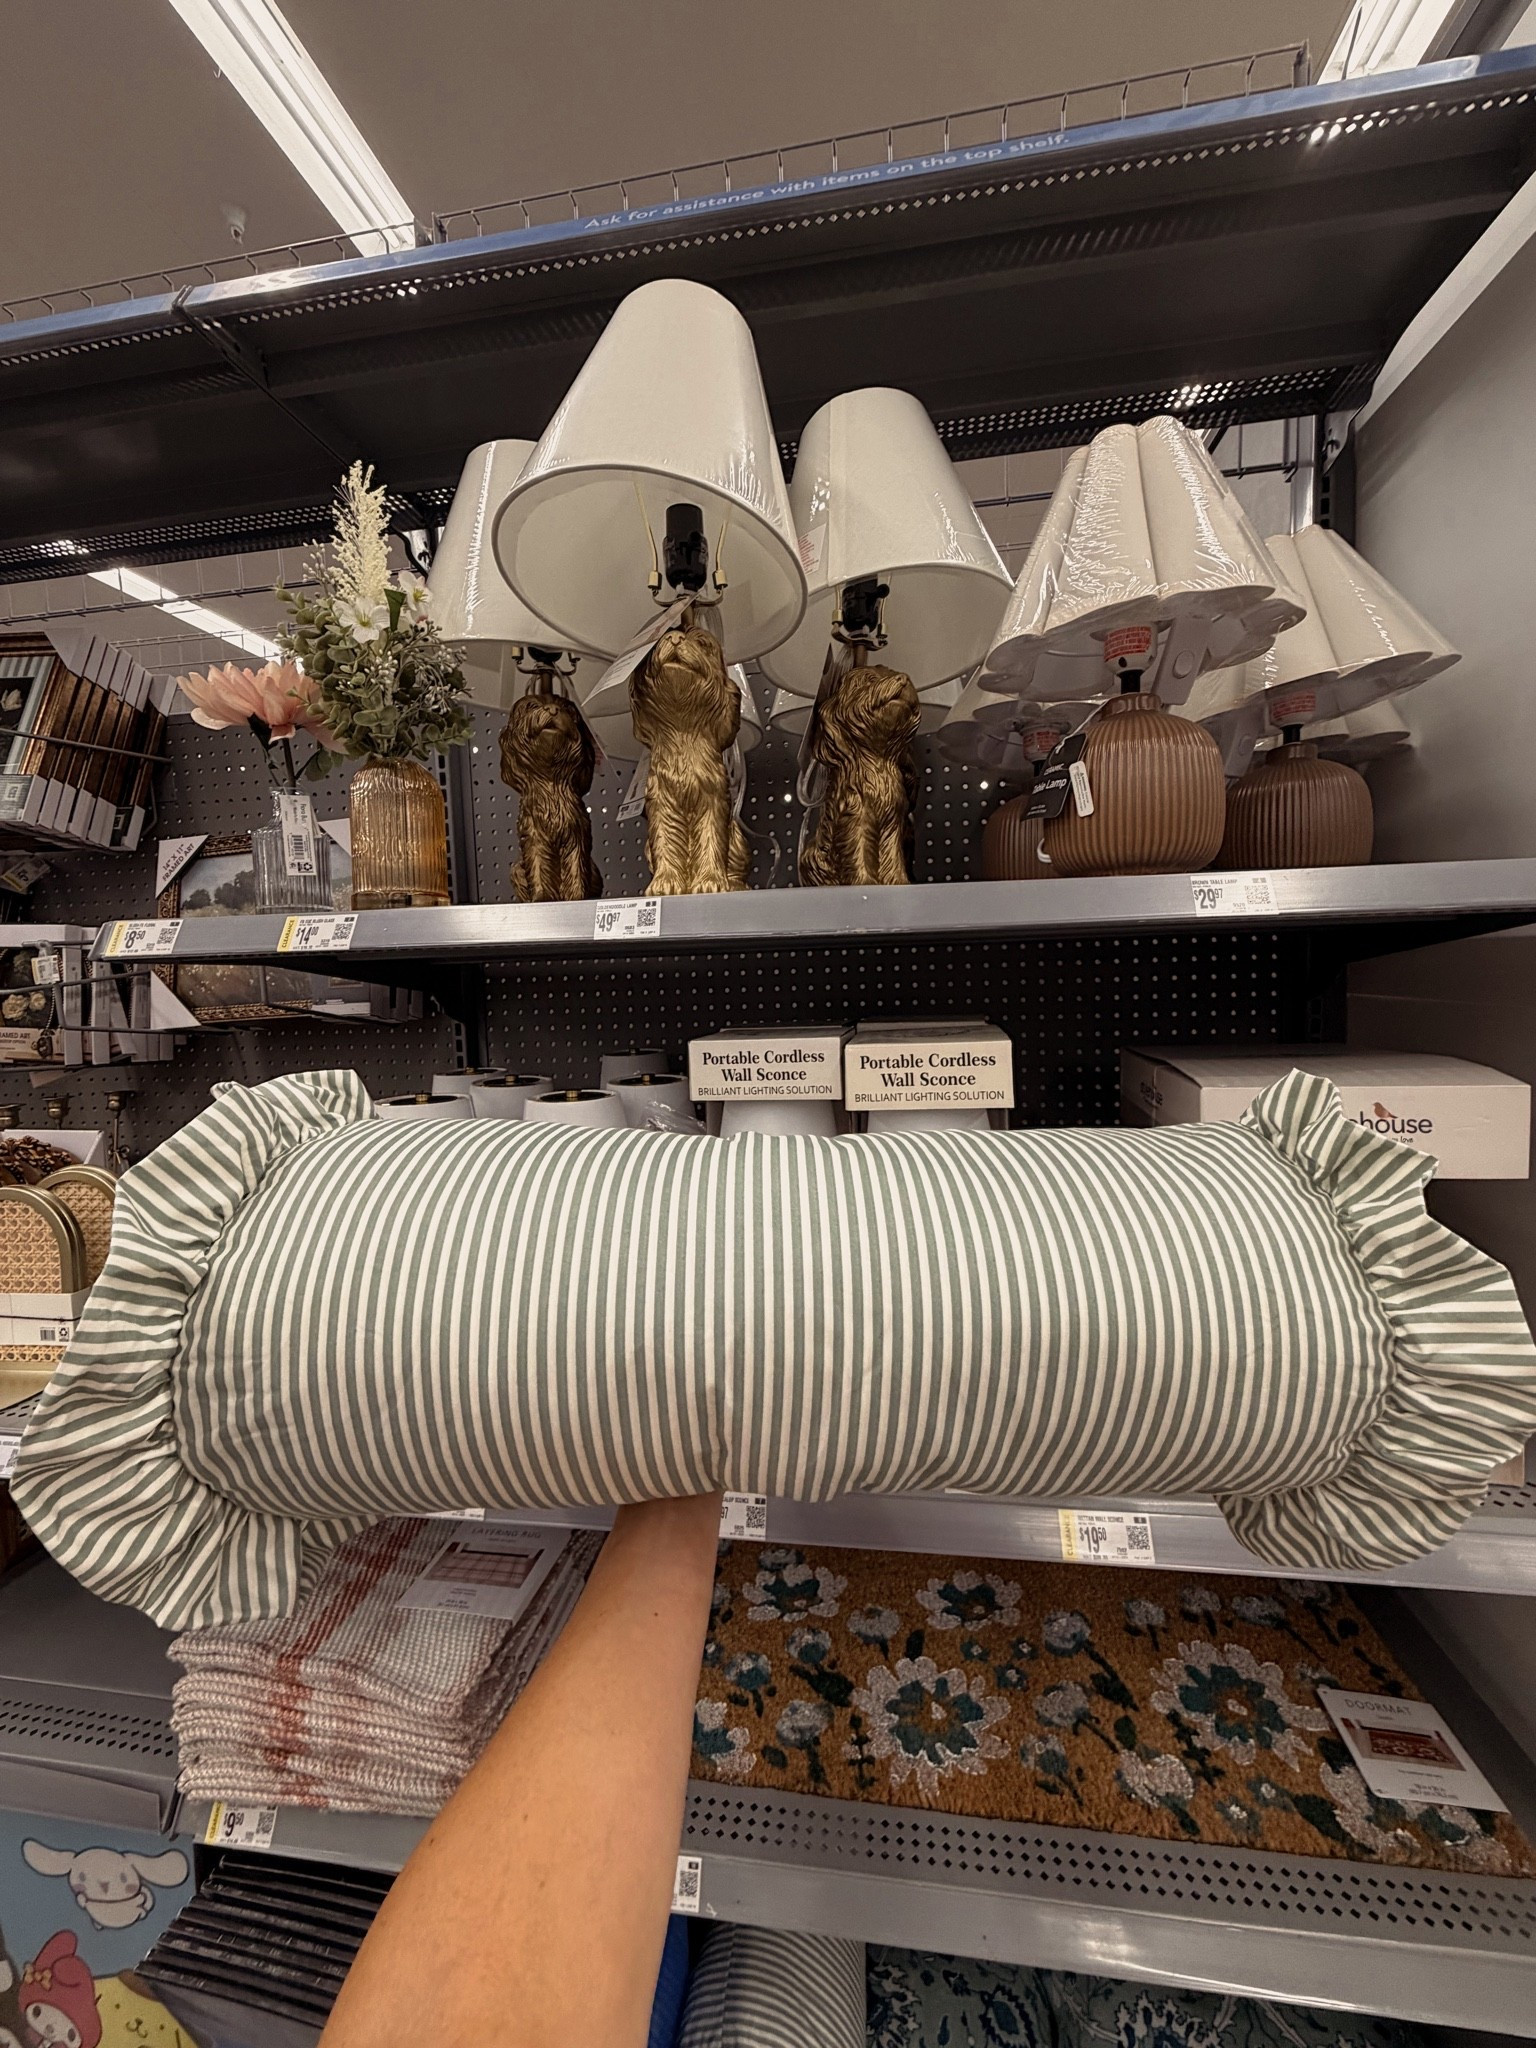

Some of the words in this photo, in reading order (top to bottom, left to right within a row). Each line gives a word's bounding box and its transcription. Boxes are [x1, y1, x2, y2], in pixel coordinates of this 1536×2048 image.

[584, 214, 622, 229] Ask
[627, 208, 659, 223] for
[661, 190, 765, 218] assistance
[770, 179, 815, 198] with
[821, 168, 881, 189] items
[886, 161, 914, 176] on
[919, 154, 957, 171] the
[963, 148, 1003, 167] top
[1006, 135, 1071, 159] shelf.
[1045, 778, 1068, 789] Lamp
[162, 855, 184, 881] FRAMED
[184, 843, 195, 856] ART
[109, 924, 124, 953] CLEARANCE
[281, 919, 295, 948] CLEARANCE
[702, 1050, 760, 1066] Portable
[764, 1049, 825, 1064] Cordless
[859, 1054, 924, 1070] Portable
[928, 1053, 997, 1068] Cordless
[721, 1068, 751, 1083] Wall
[756, 1067, 807, 1081] Sconce
[880, 1072, 915, 1087] Wall
[919, 1071, 977, 1087] Sconce
[698, 1086, 741, 1096] BRILLIANT
[743, 1085, 785, 1095] LIGHTING
[786, 1084, 833, 1095] SOLUTION
[854, 1093, 903, 1103] BRILLIANT
[905, 1091, 951, 1102] LIGHTING
[952, 1090, 1005, 1101] SOLUTION
[1344, 1699, 1412, 1715] DOORMAT
